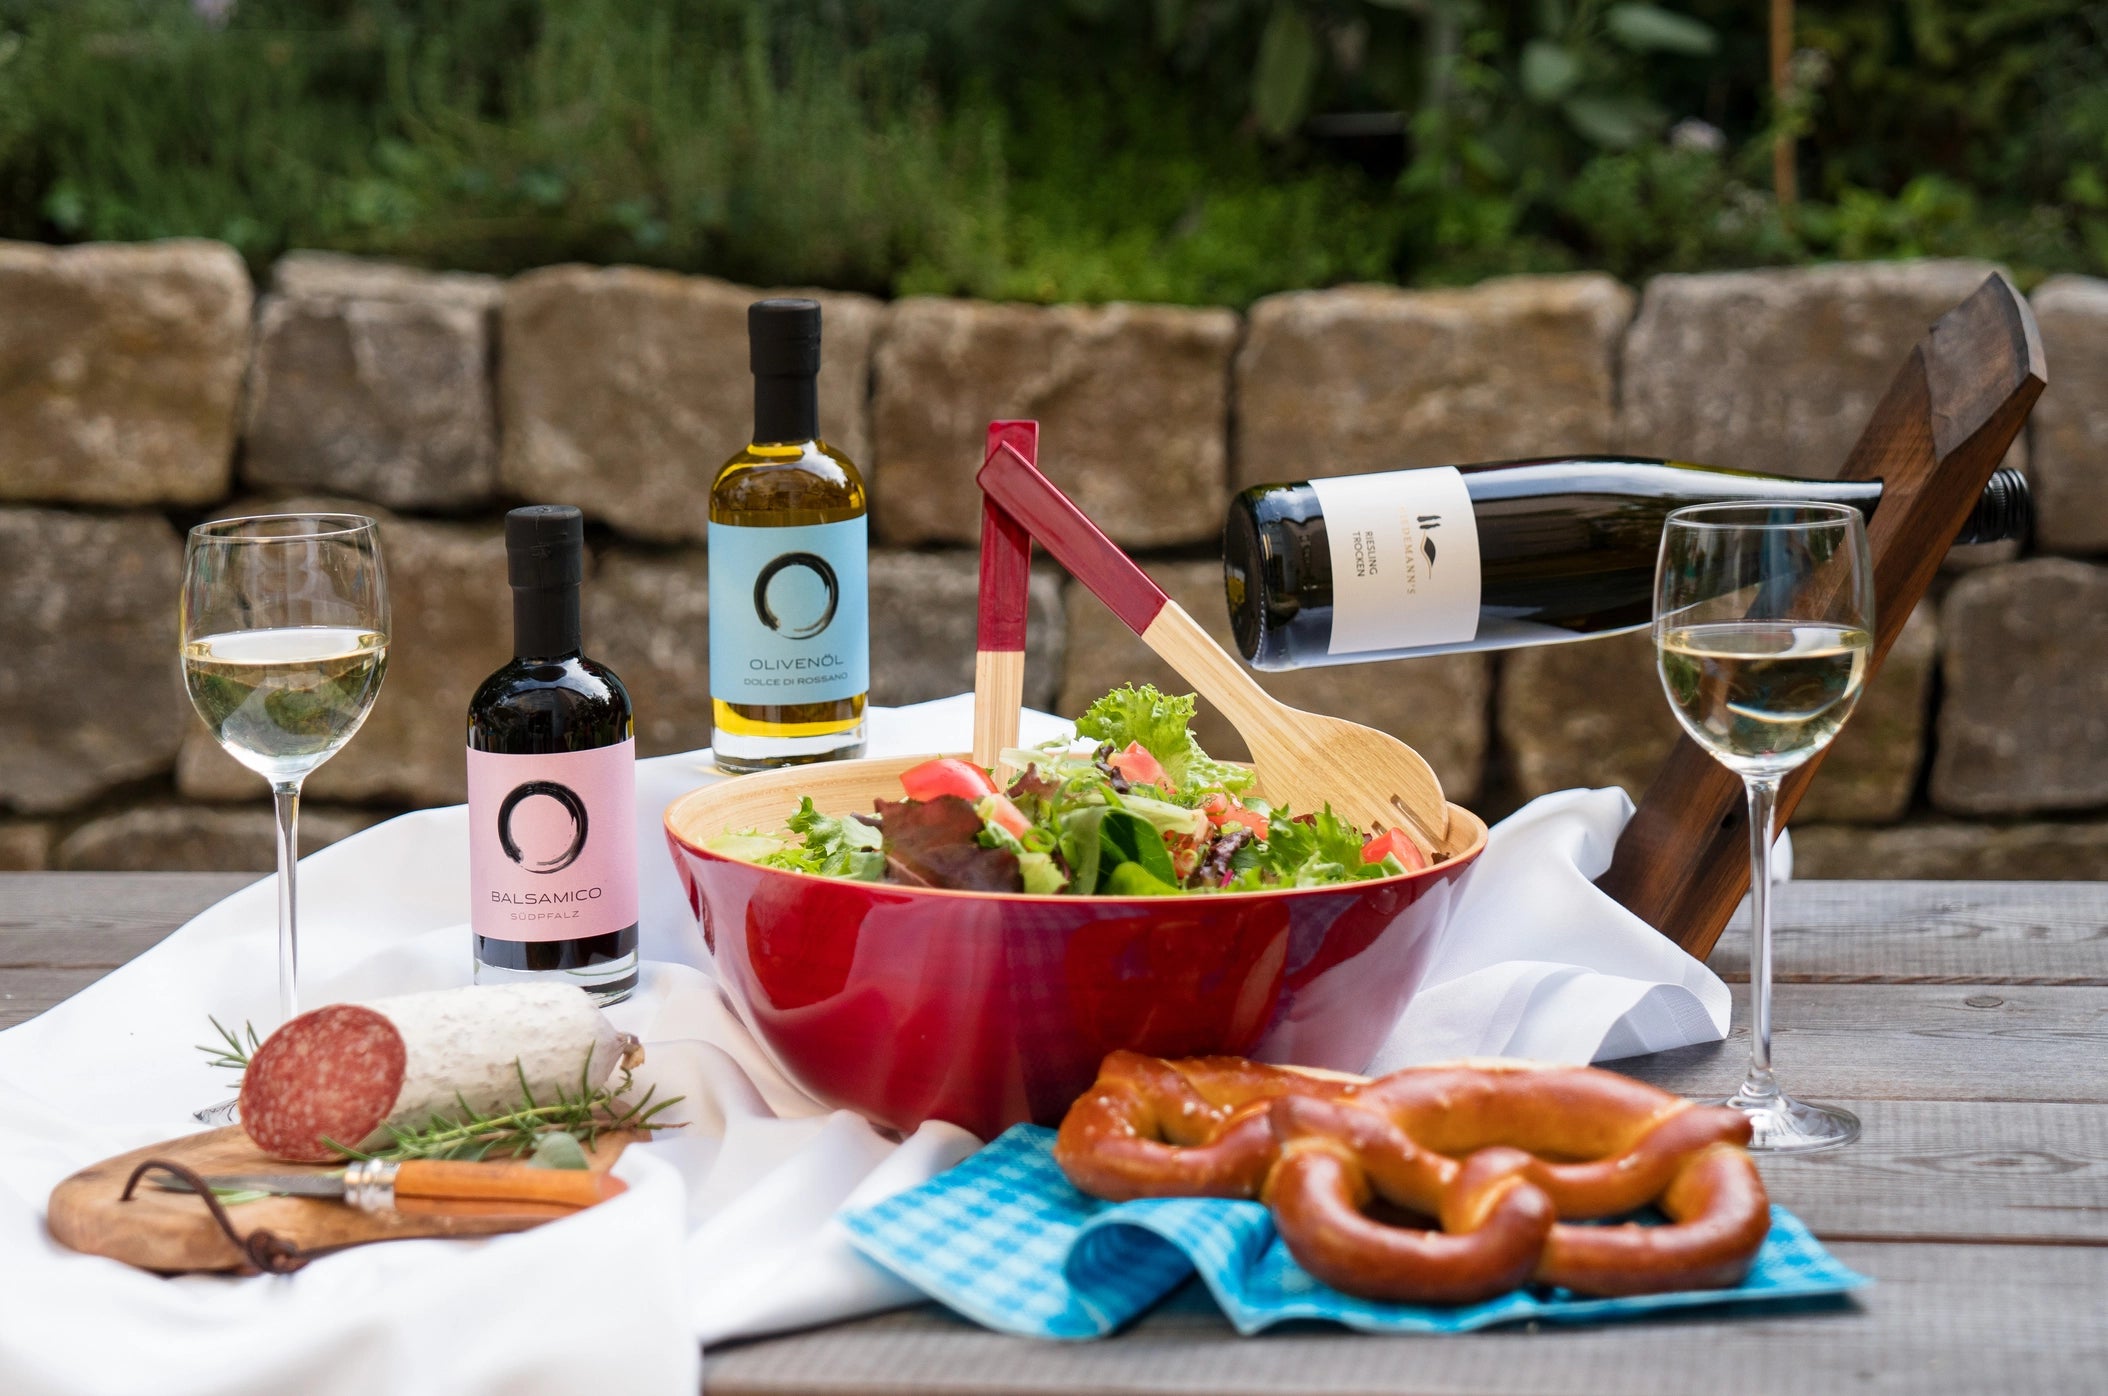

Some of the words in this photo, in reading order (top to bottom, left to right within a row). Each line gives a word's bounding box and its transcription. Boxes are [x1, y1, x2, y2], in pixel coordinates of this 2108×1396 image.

[1352, 531, 1365, 577] TROCKEN
[1365, 531, 1378, 576] RIESLING
[1399, 503, 1416, 595] DEMANN'S
[749, 653, 844, 670] OLIVENÖL
[743, 677, 781, 686] DOLCE
[783, 678, 795, 686] DI
[797, 672, 848, 685] ROSSANO
[491, 887, 602, 905] BALSAMICO
[510, 910, 580, 921] SÜDPFALZ
